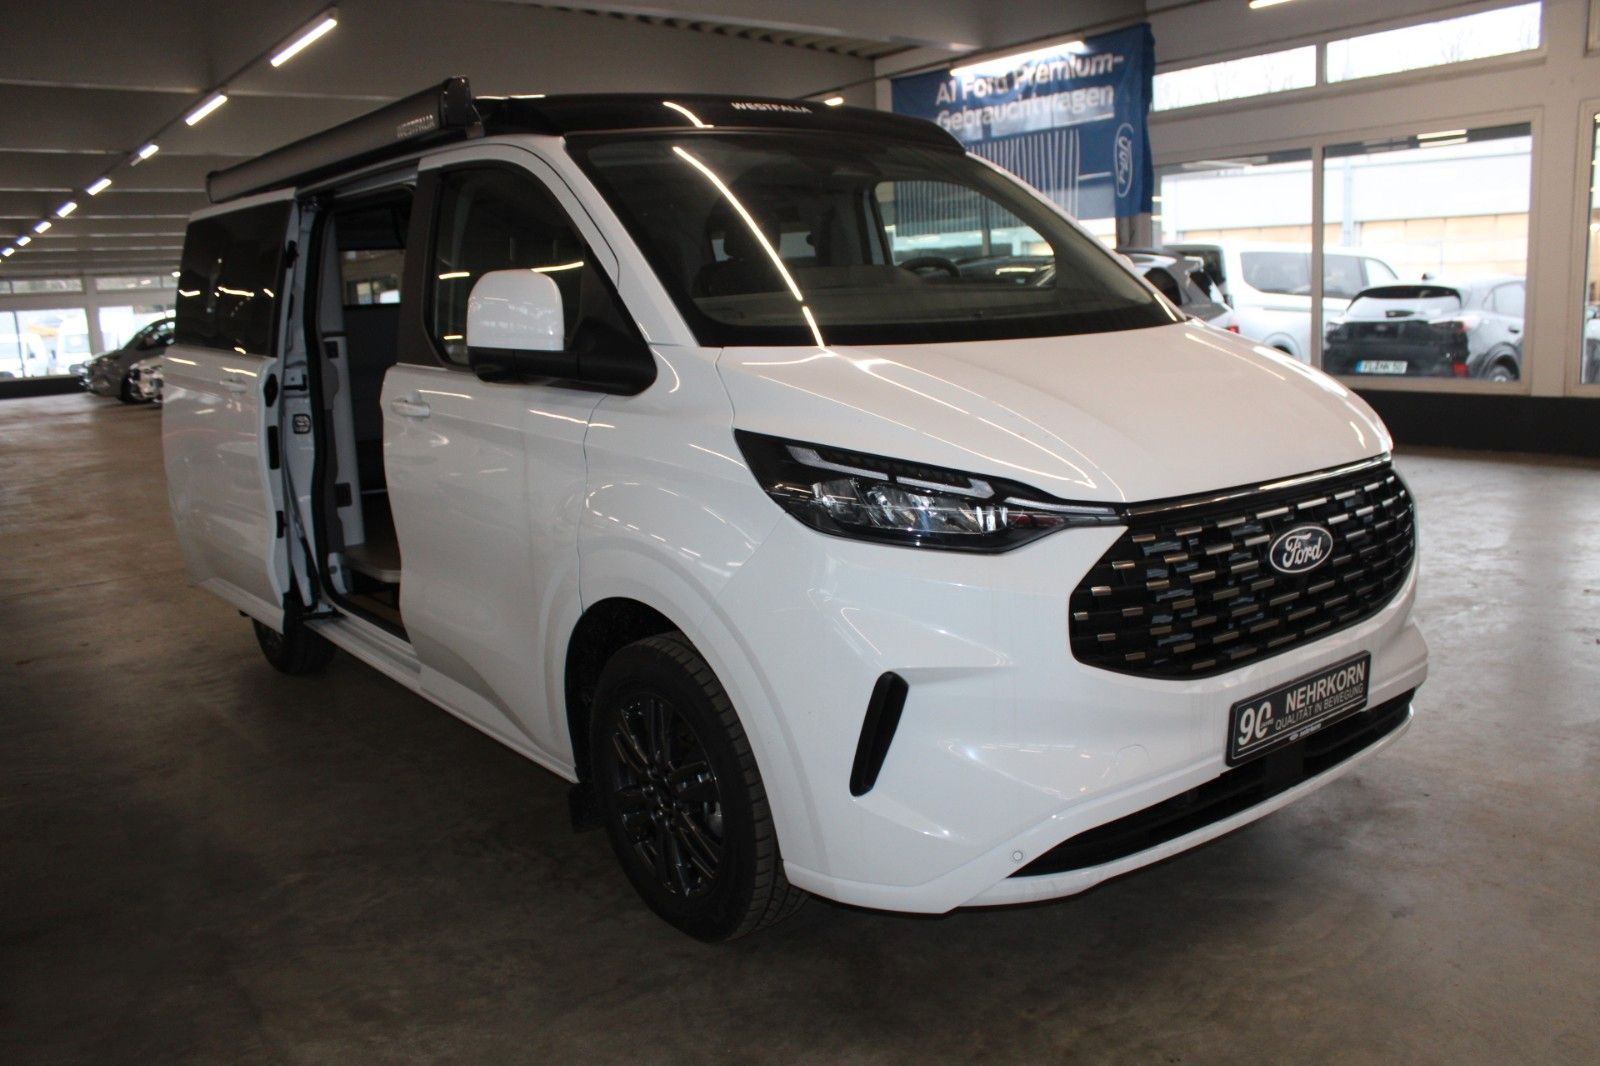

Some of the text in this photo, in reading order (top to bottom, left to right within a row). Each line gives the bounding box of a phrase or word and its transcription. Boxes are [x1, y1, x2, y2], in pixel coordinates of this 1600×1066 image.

[731, 102, 813, 114] WESTFALIA
[935, 84, 1114, 131] Gebrauchtwagen
[936, 79, 957, 105] A1
[1282, 532, 1323, 568] Ford
[1285, 661, 1366, 714] NEHRKORN
[1323, 682, 1364, 710] BEWEGUNG
